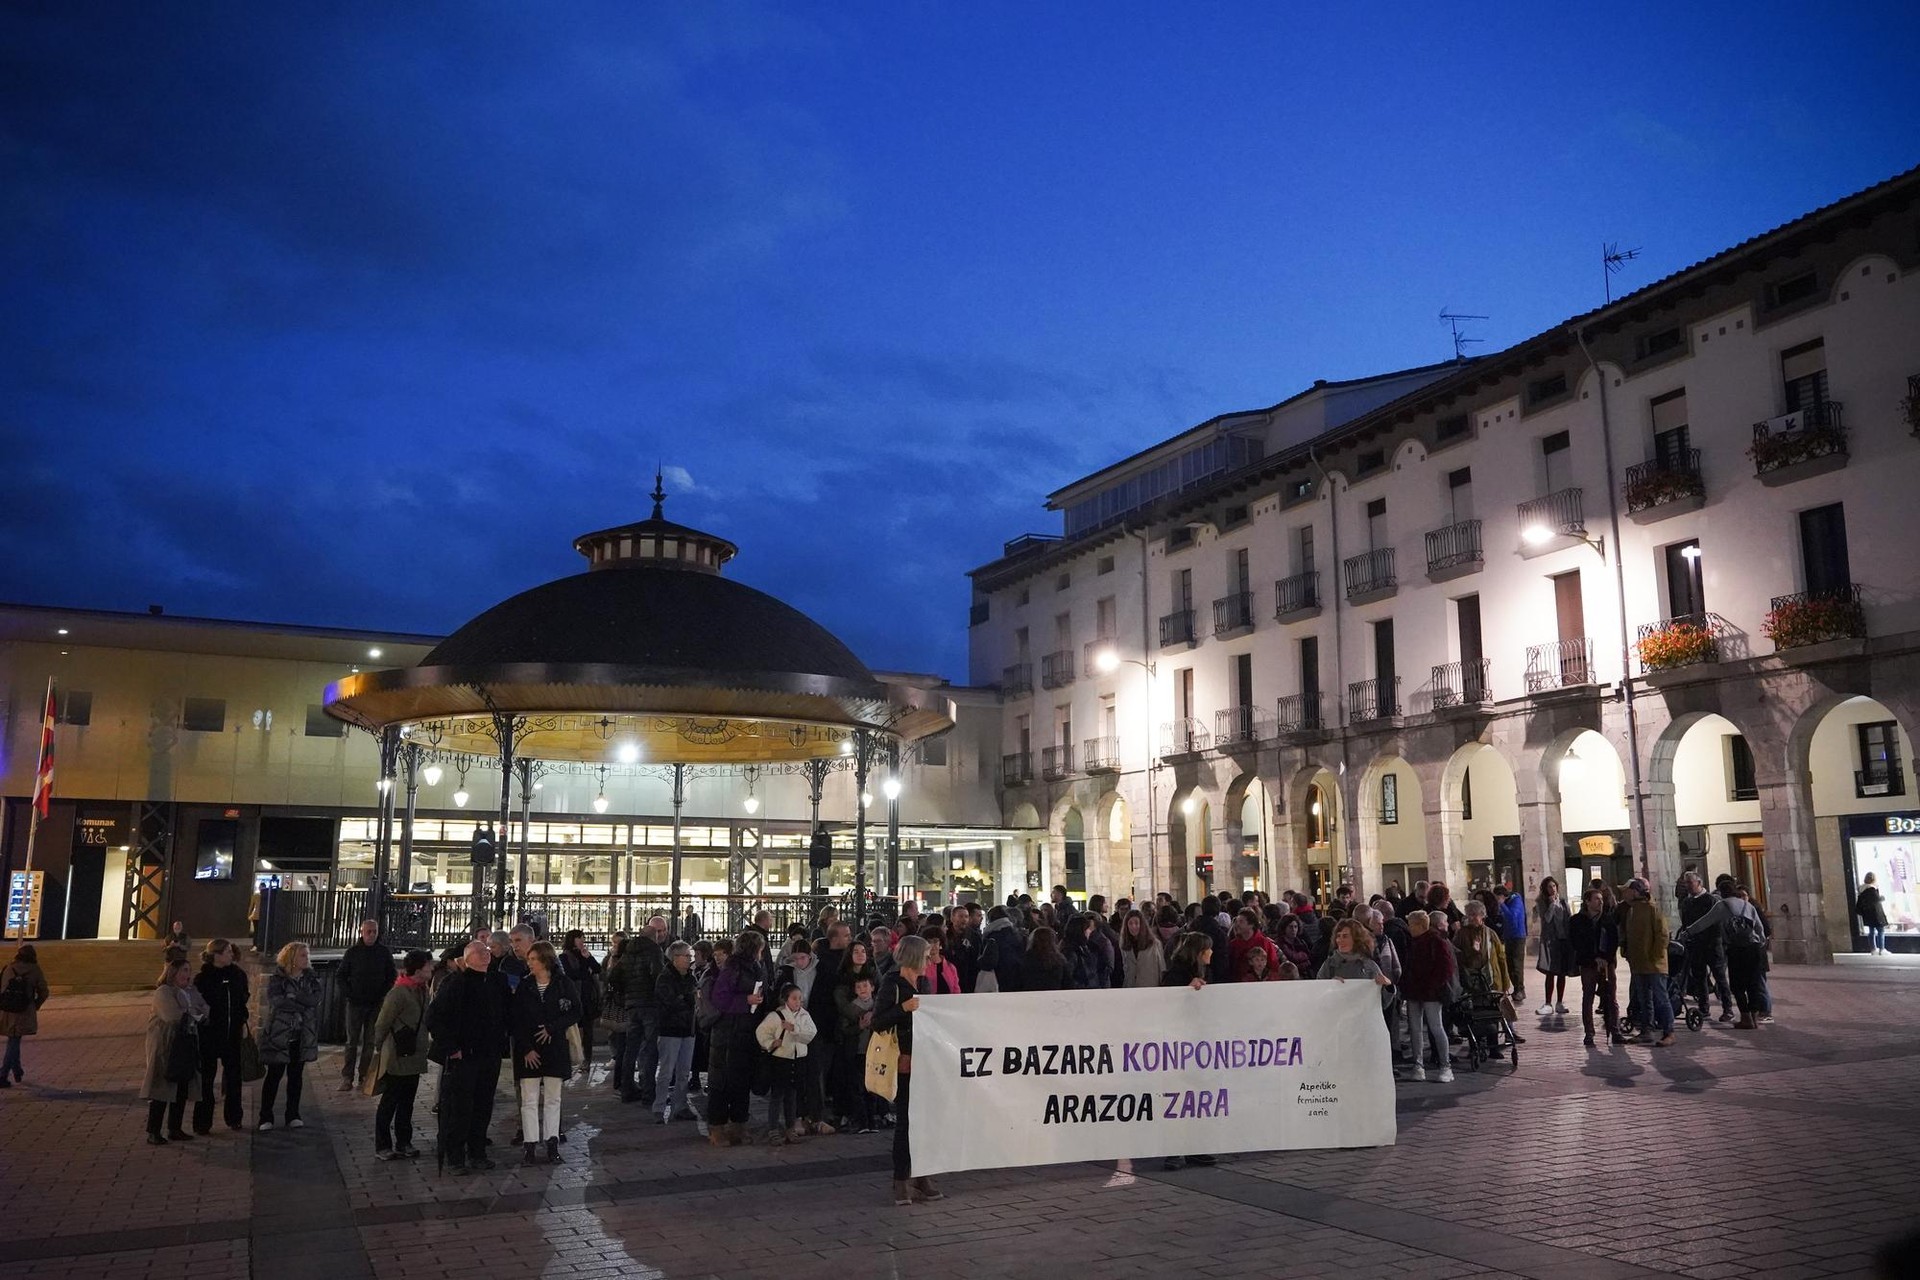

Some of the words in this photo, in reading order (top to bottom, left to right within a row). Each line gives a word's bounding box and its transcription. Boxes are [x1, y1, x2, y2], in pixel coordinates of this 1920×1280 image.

[960, 1047, 993, 1077] EZ
[1002, 1043, 1114, 1076] BAZARA
[1122, 1037, 1304, 1072] KONPONBIDEA
[1299, 1081, 1337, 1092] Azpeitiko
[1043, 1093, 1154, 1124] ARAZOA
[1163, 1088, 1230, 1119] ZARA
[1297, 1095, 1338, 1104] feministan
